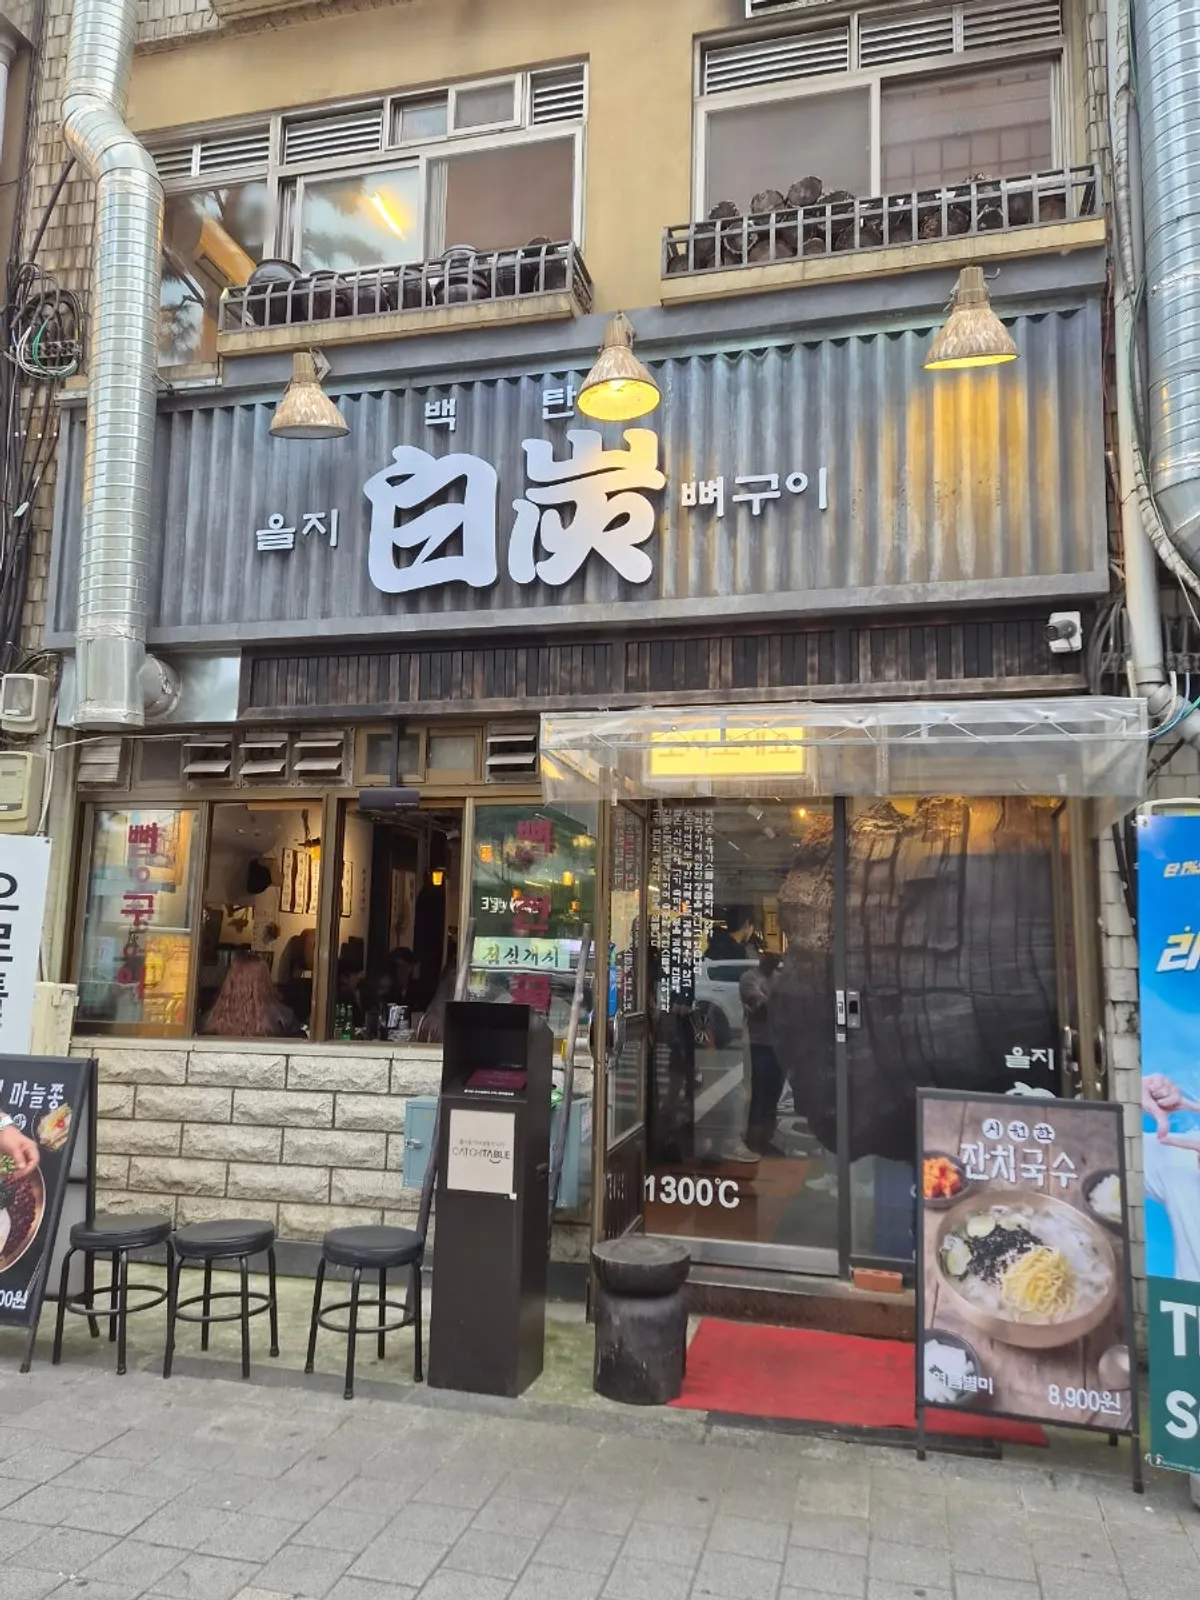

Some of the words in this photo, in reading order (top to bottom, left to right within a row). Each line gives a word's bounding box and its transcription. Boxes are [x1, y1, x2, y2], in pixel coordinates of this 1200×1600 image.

[424, 398, 457, 432] 백
[542, 385, 578, 421] 탄
[362, 427, 667, 594] 白炭
[681, 467, 828, 518] 뼈구이
[255, 508, 339, 552] 을지
[116, 821, 159, 1001] 뼈구이
[482, 943, 559, 968] 점심개시
[1004, 1046, 1055, 1071] 을지
[9, 1080, 65, 1110] 마늘쫑
[983, 1120, 1054, 1142] 시원한
[960, 1141, 1079, 1189] 잔치국수
[1159, 1299, 1200, 1357] T
[1048, 1383, 1122, 1416] 8,900원
[1164, 1388, 1200, 1440] S
